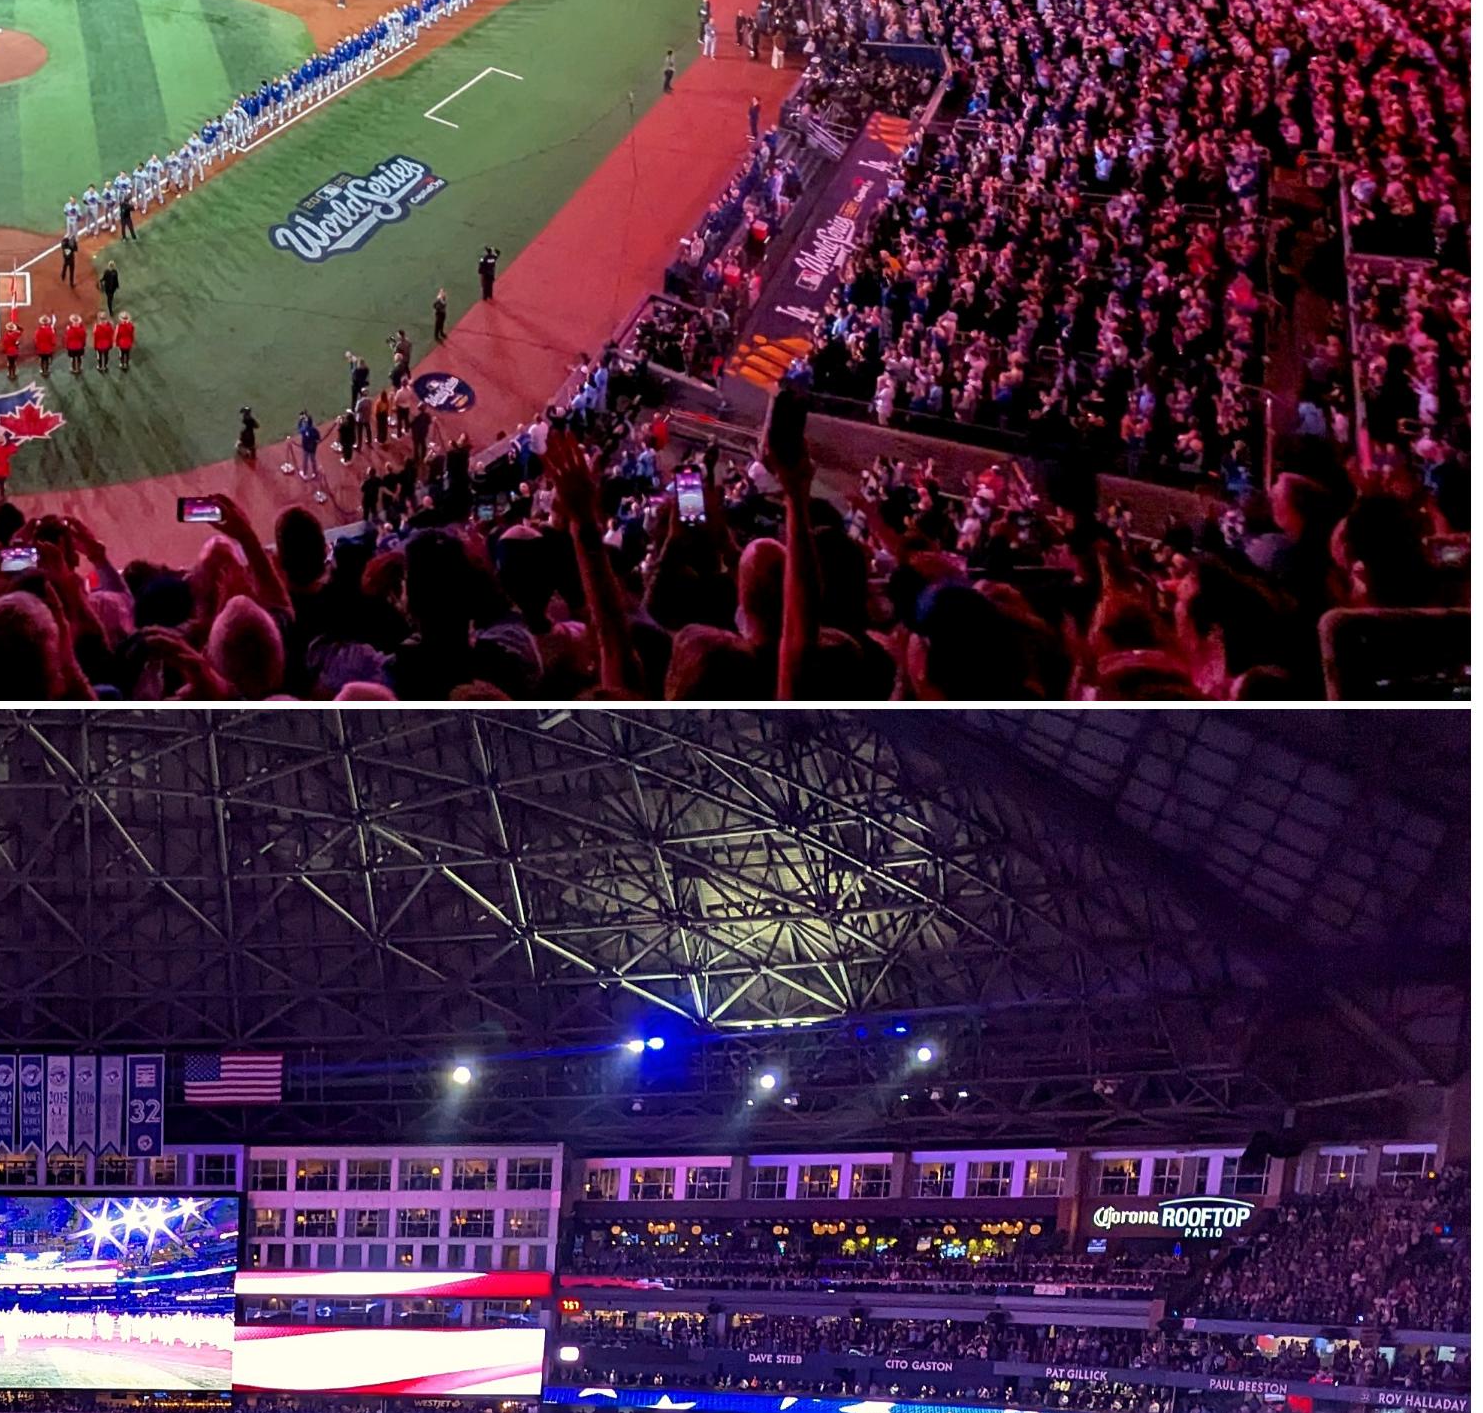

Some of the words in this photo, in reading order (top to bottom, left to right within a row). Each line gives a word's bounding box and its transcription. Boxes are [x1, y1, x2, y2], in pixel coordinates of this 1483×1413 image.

[274, 185, 372, 259] World
[354, 156, 426, 213] Series
[129, 1098, 161, 1124] 32
[1093, 1205, 1159, 1230] Corona
[1161, 1207, 1251, 1227] ROOFTOP
[1184, 1227, 1223, 1238] PATIO
[748, 1352, 773, 1364] DAVE
[776, 1353, 803, 1365] STIEB
[884, 1359, 908, 1370] CITO
[911, 1360, 953, 1372] GASTON
[1045, 1367, 1065, 1379] PAT
[1066, 1369, 1108, 1381] GILLICK
[1209, 1378, 1233, 1390] PAUL
[1238, 1380, 1288, 1394] BEESTON
[414, 1399, 452, 1410] WESTJET
[1378, 1392, 1402, 1405] ROY
[1404, 1395, 1468, 1412] HALLADAY
